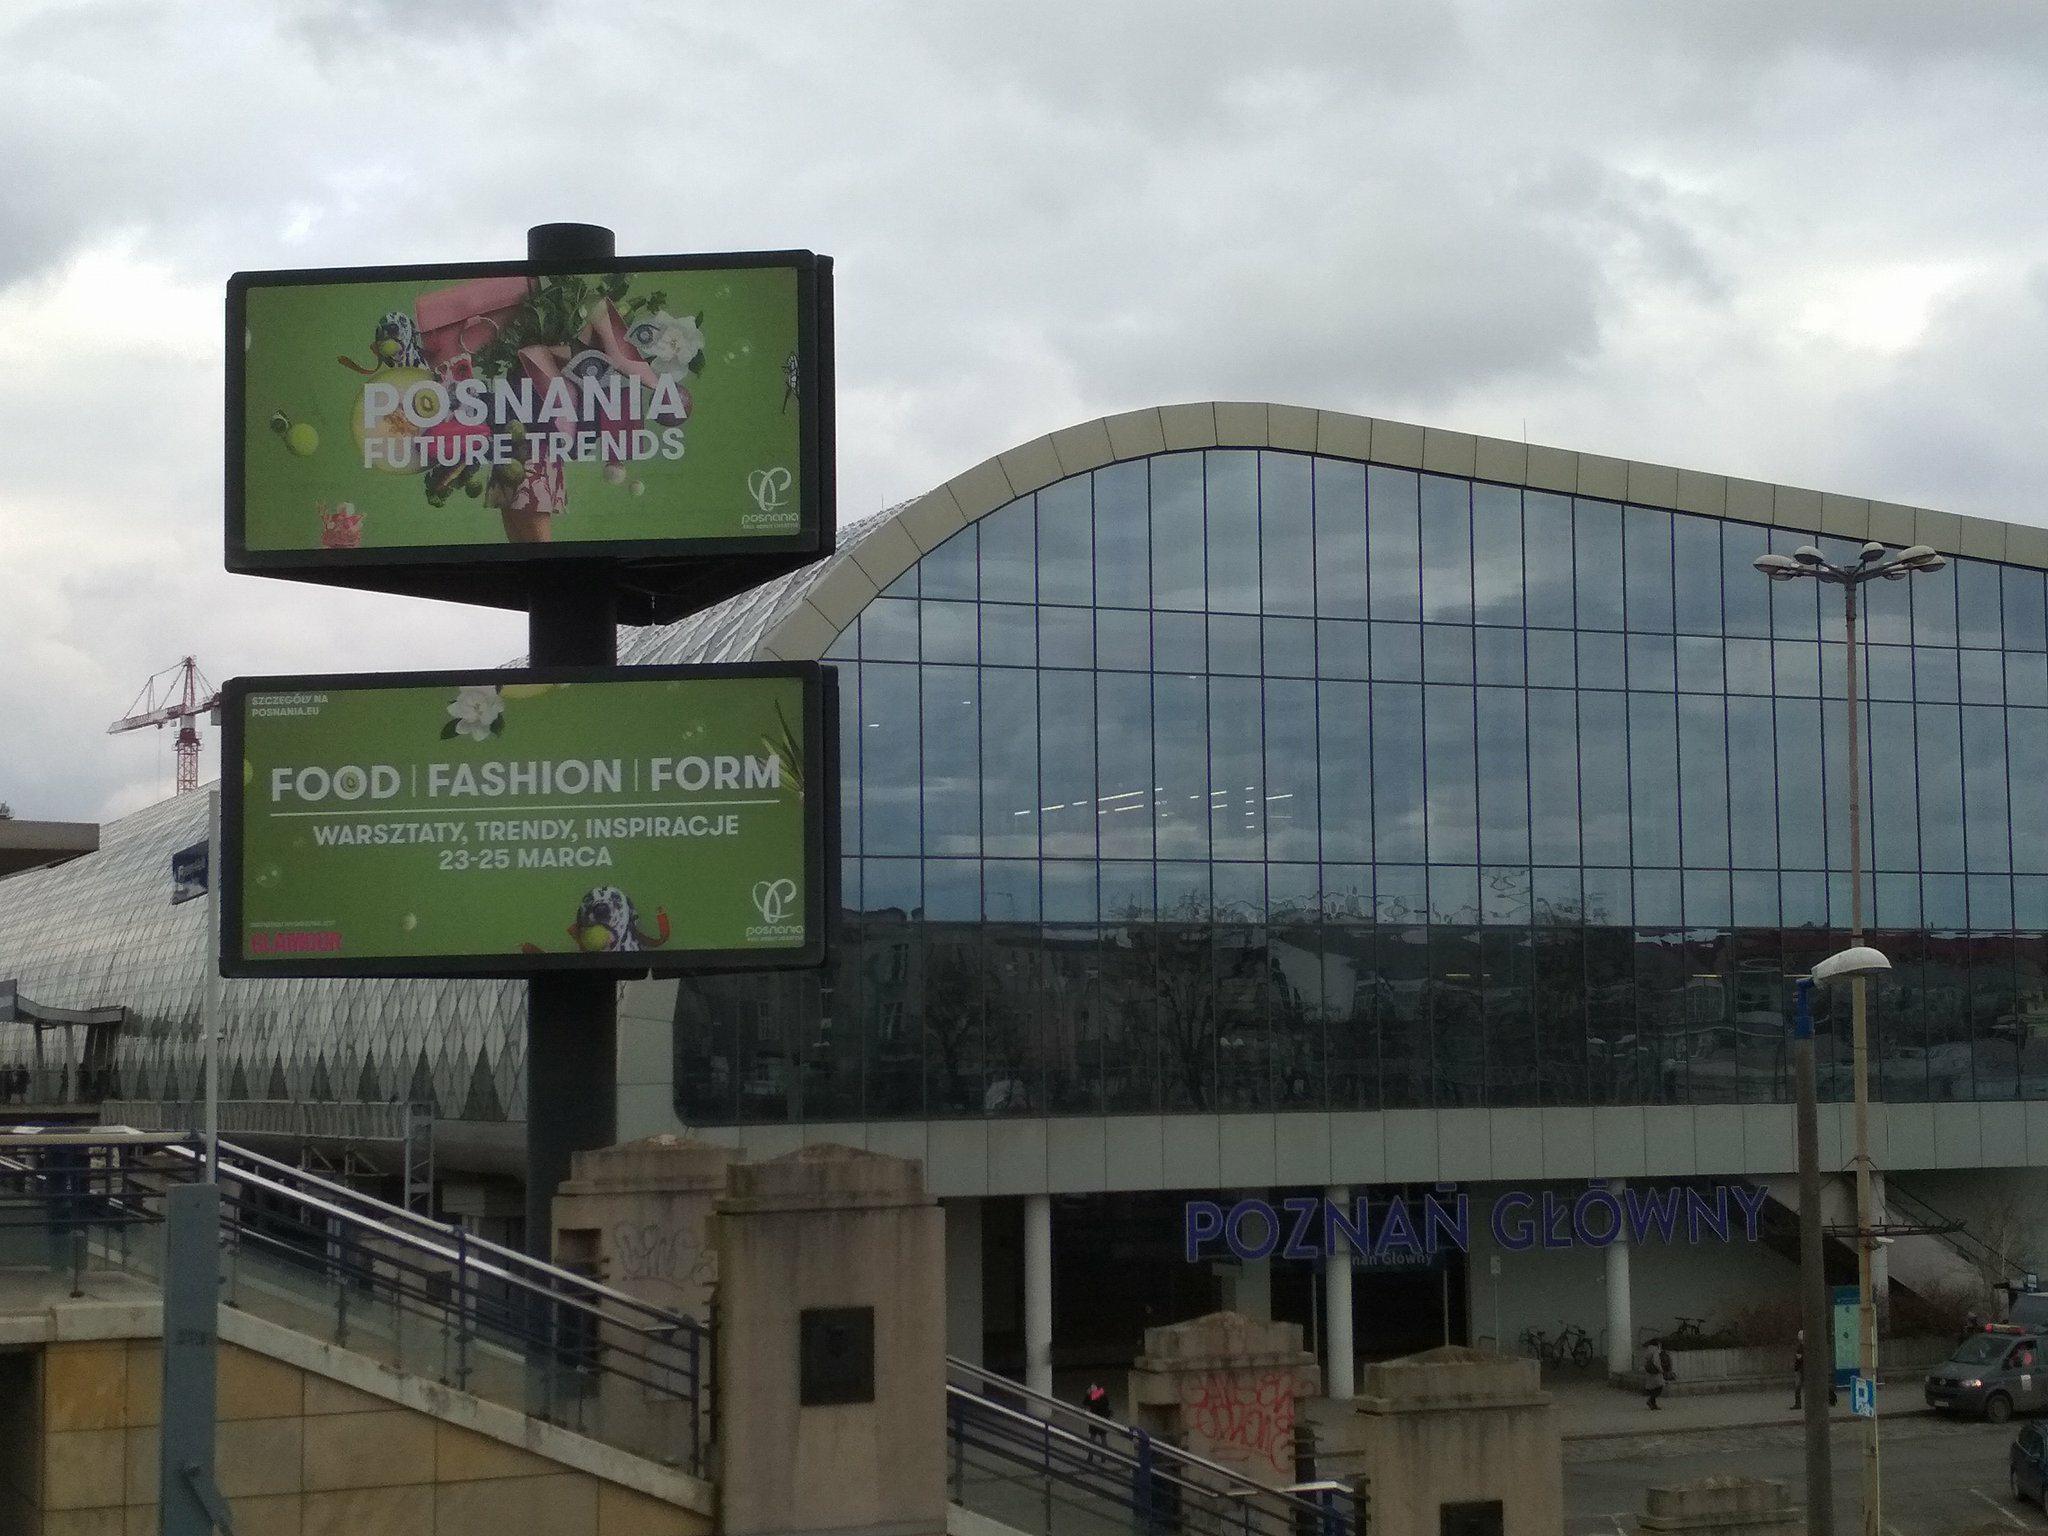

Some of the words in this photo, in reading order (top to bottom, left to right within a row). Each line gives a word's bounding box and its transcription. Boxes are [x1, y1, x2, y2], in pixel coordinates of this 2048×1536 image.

[363, 372, 688, 429] POSNANIA
[363, 434, 513, 469] FUTURE
[523, 427, 686, 463] TRENDS
[252, 707, 319, 717] POSNANIA.EU
[313, 695, 329, 703] NA
[271, 765, 400, 801] FOOD
[428, 758, 622, 797] FASHION
[651, 754, 781, 792] FORM
[313, 822, 468, 846] WARSZTATY,
[475, 819, 579, 843] TRENDY,
[586, 815, 739, 840] INSPIRACJE
[439, 849, 510, 870] 23-25
[518, 846, 613, 868] MARCA
[1186, 1182, 1469, 1263] POZNAŃ
[1491, 1177, 1769, 1250] GŁÓWNY
